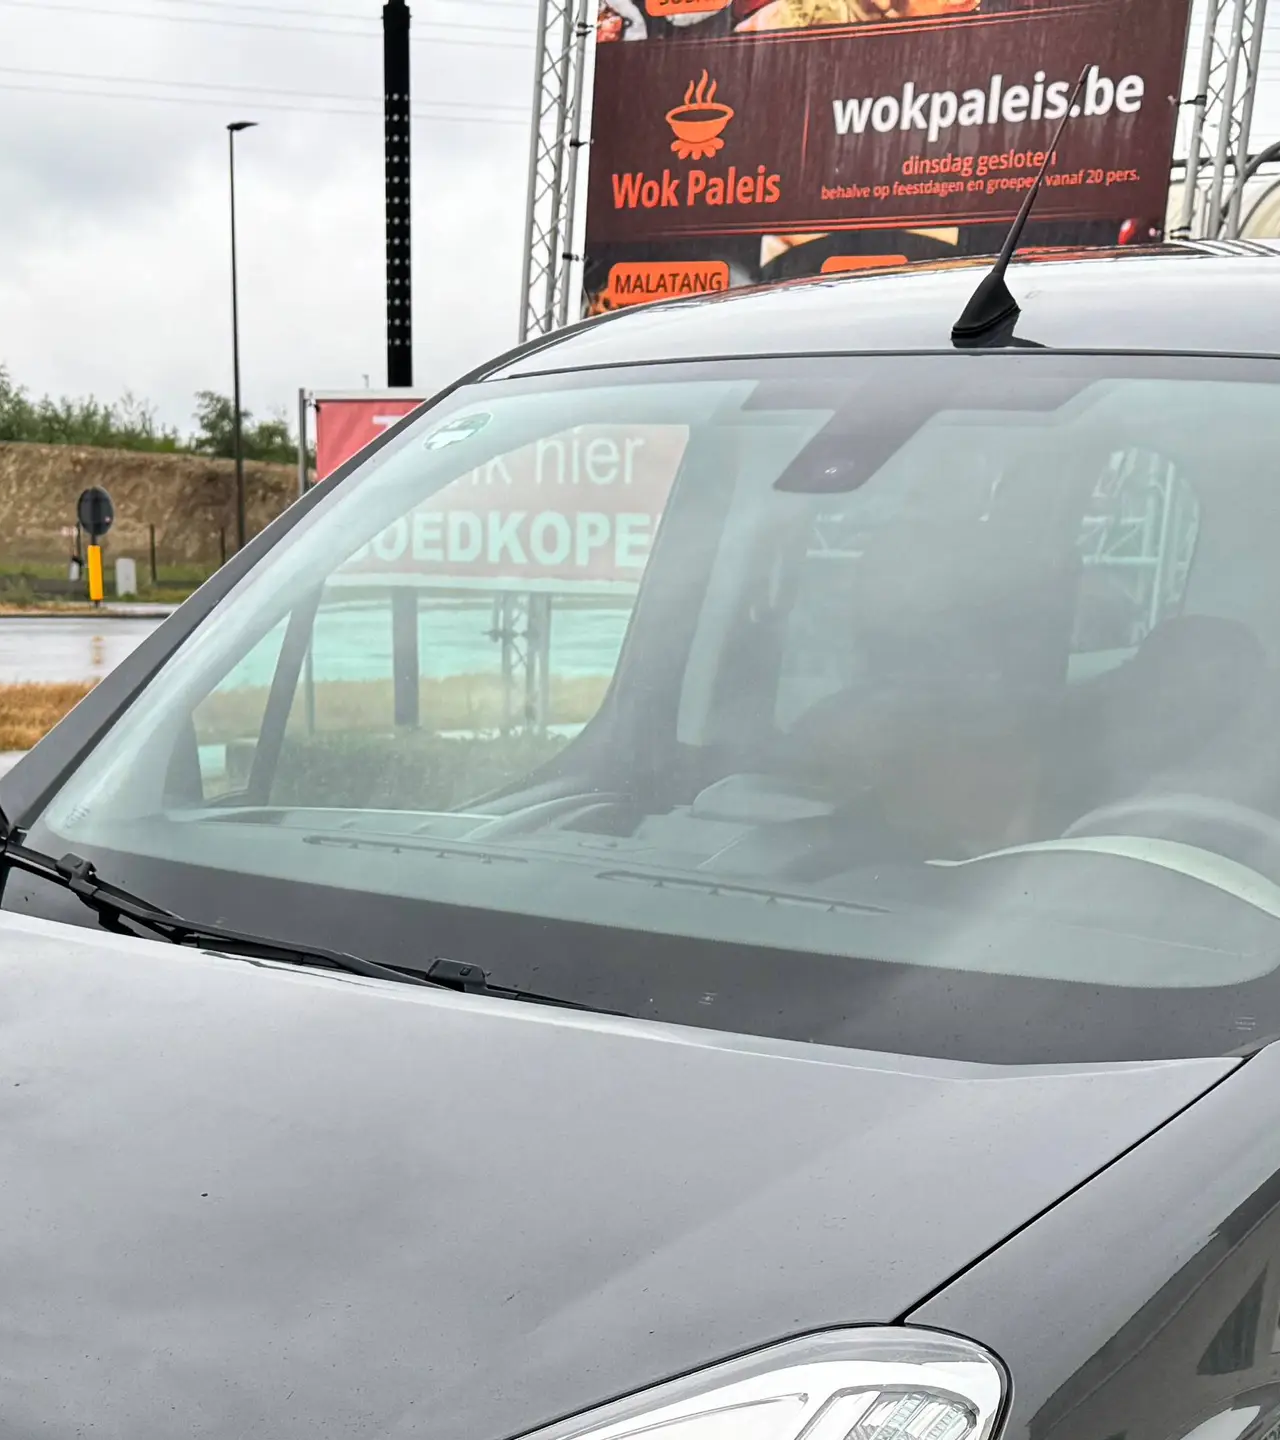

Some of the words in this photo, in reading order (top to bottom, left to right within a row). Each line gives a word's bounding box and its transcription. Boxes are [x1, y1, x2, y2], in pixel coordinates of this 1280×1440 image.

[832, 64, 1144, 142] wokpaleis.be
[902, 153, 973, 177] dinsdag
[612, 169, 680, 208] Wok
[687, 165, 781, 206] Paleis
[821, 183, 870, 200] behalve
[873, 185, 890, 200] op
[893, 180, 964, 198] feestdagen
[967, 180, 984, 192] en
[1045, 168, 1085, 186] vanaf
[1086, 168, 1103, 184] 20
[1107, 168, 1140, 186] pers.
[615, 272, 723, 293] MALATANG
